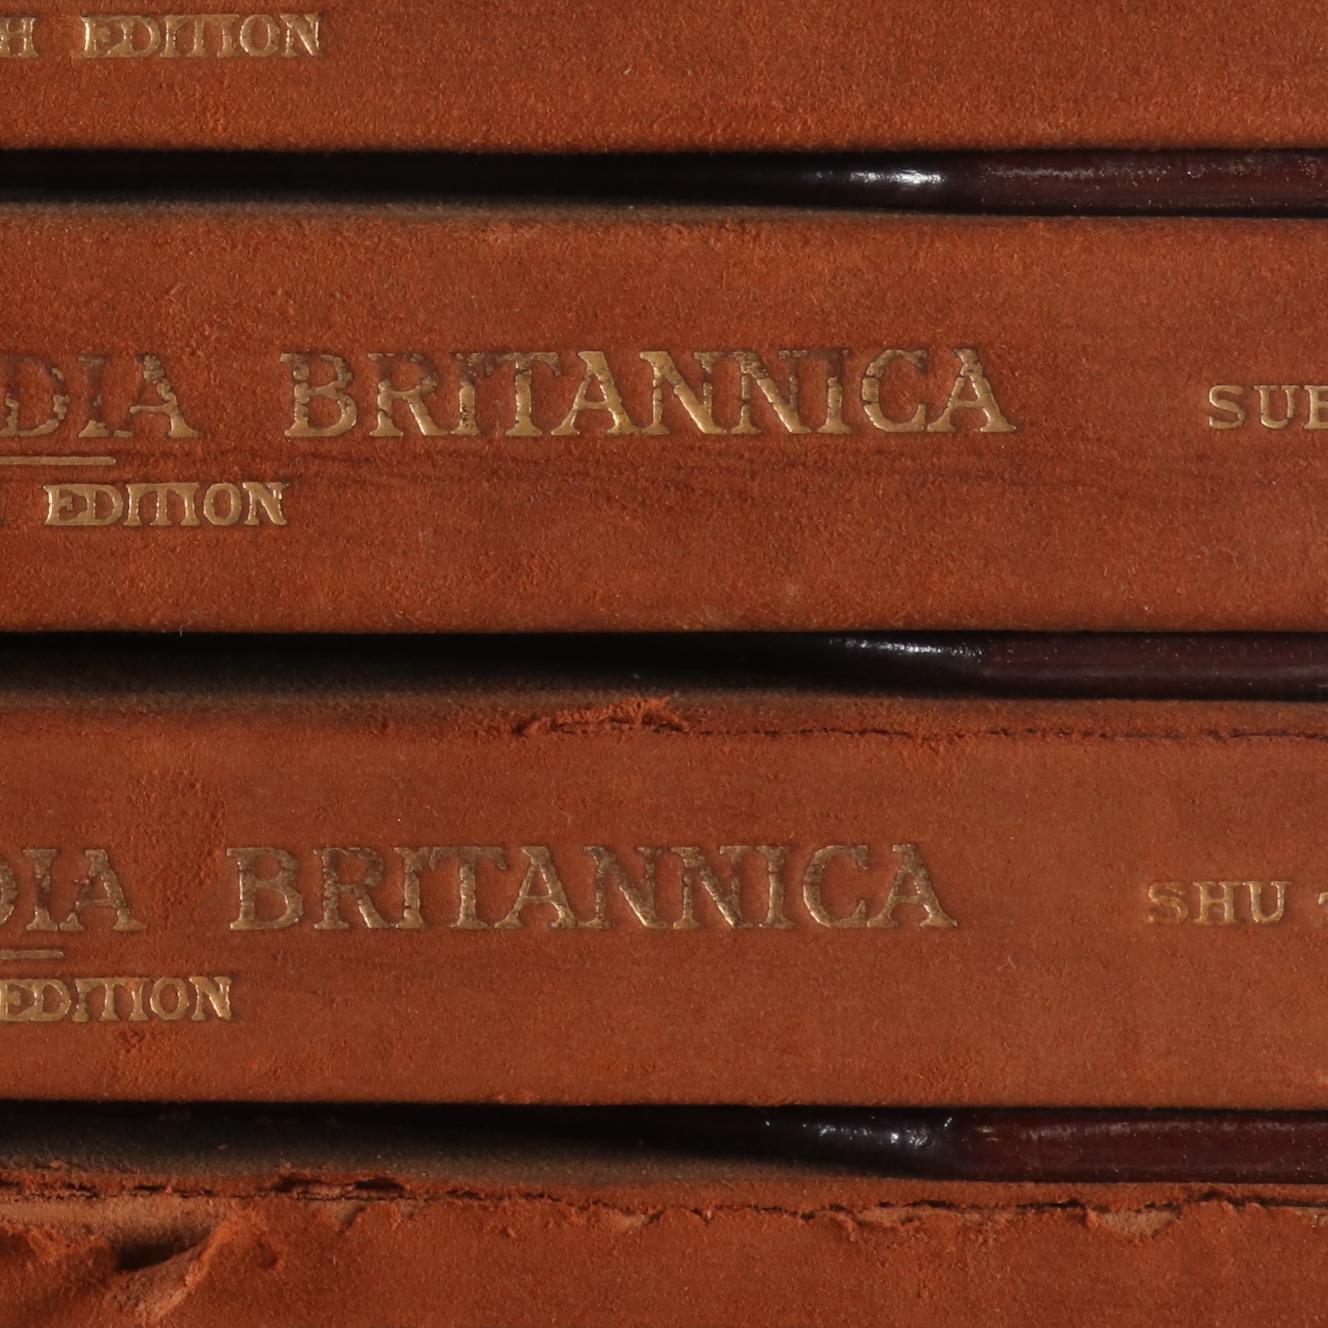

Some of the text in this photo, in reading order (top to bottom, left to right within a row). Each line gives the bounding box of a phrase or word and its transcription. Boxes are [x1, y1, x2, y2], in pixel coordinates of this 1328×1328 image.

[80, 13, 320, 59] EDITION
[279, 349, 1017, 437] BRITANNICA
[43, 482, 289, 526] EDITION
[226, 844, 957, 930] BRITANNICA
[1144, 880, 1288, 924] SHU
